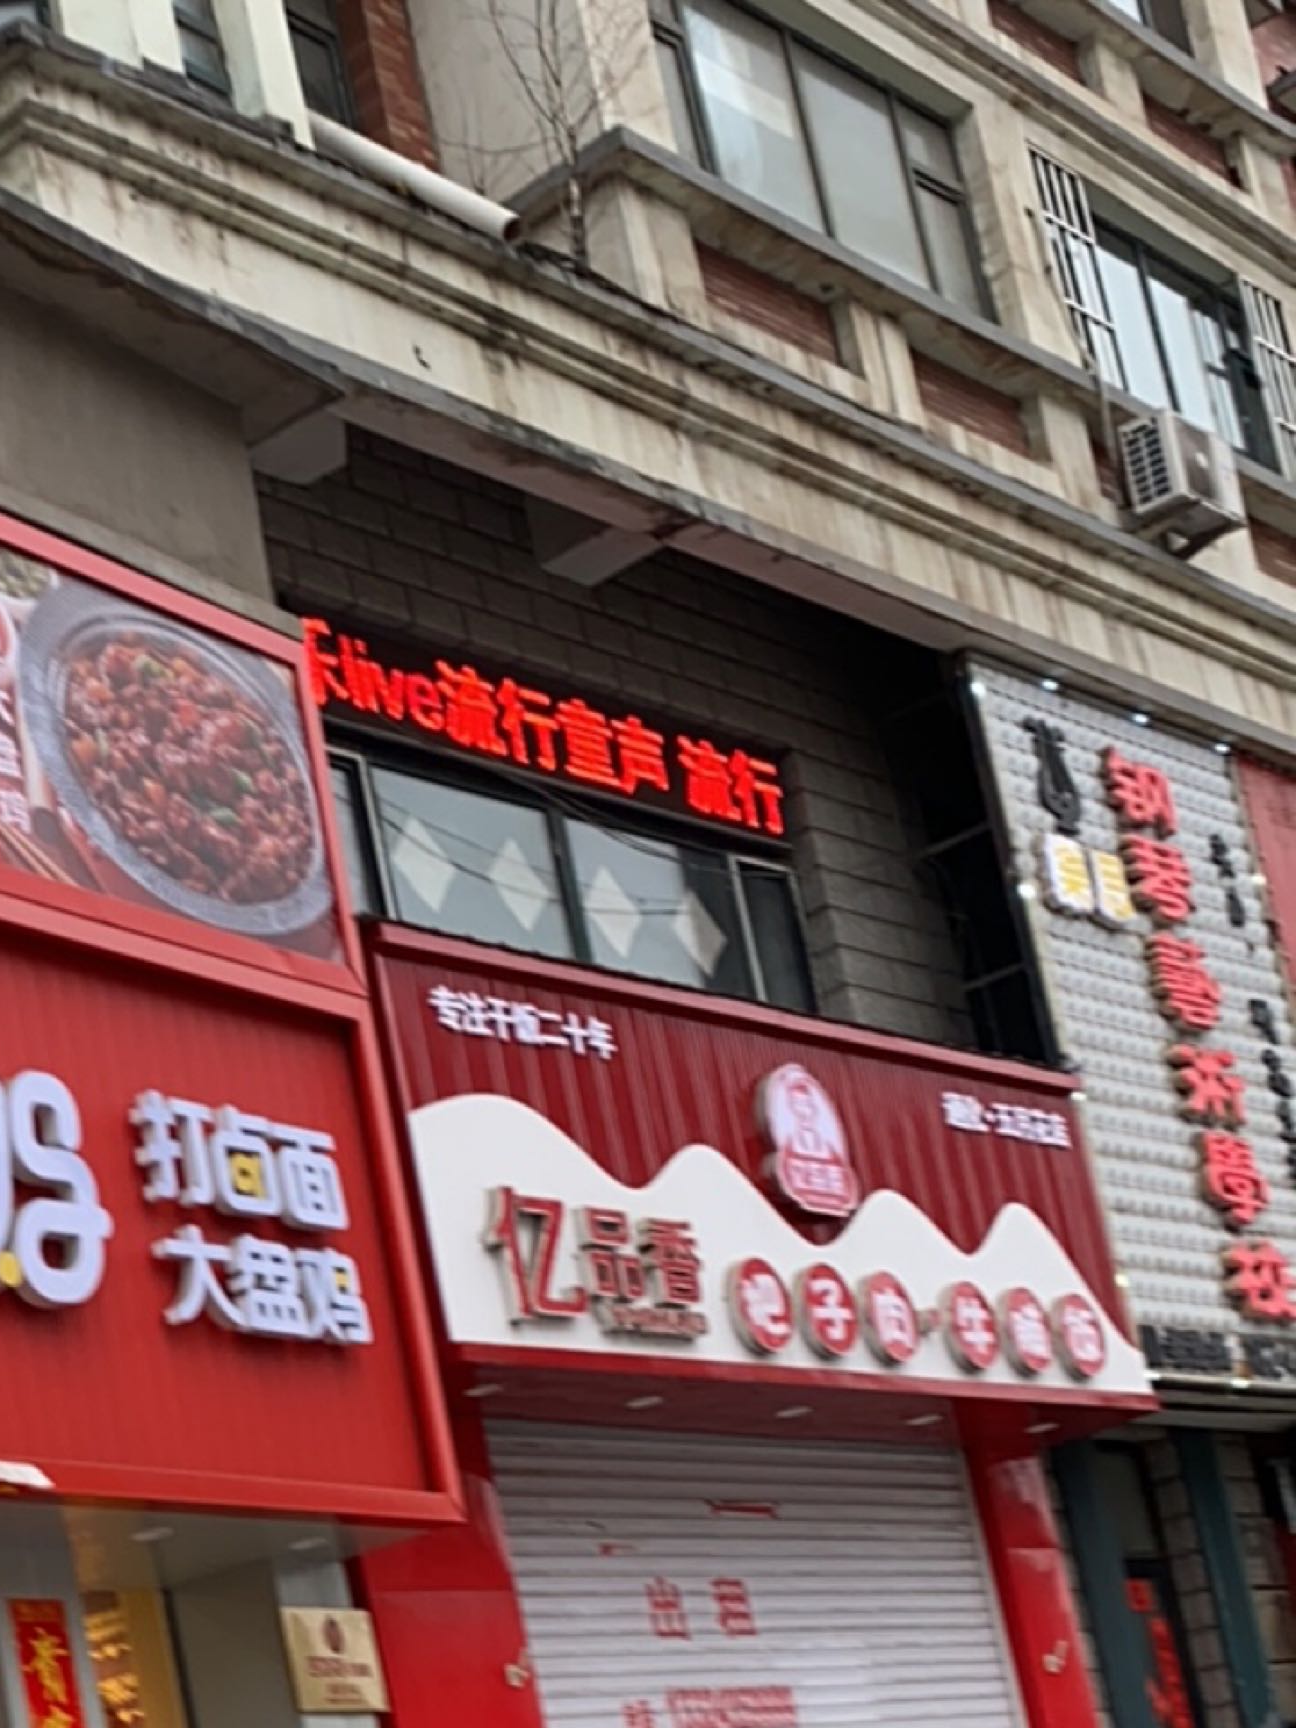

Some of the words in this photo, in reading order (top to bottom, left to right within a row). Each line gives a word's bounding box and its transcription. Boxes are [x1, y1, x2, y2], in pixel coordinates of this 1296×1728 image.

[677, 734, 784, 835] 流行
[426, 984, 620, 1060] 专注干饭二十年
[130, 1088, 350, 1231] 打卤面
[153, 1222, 372, 1345] 大盘鸡
[487, 1185, 704, 1318] 亿品香
